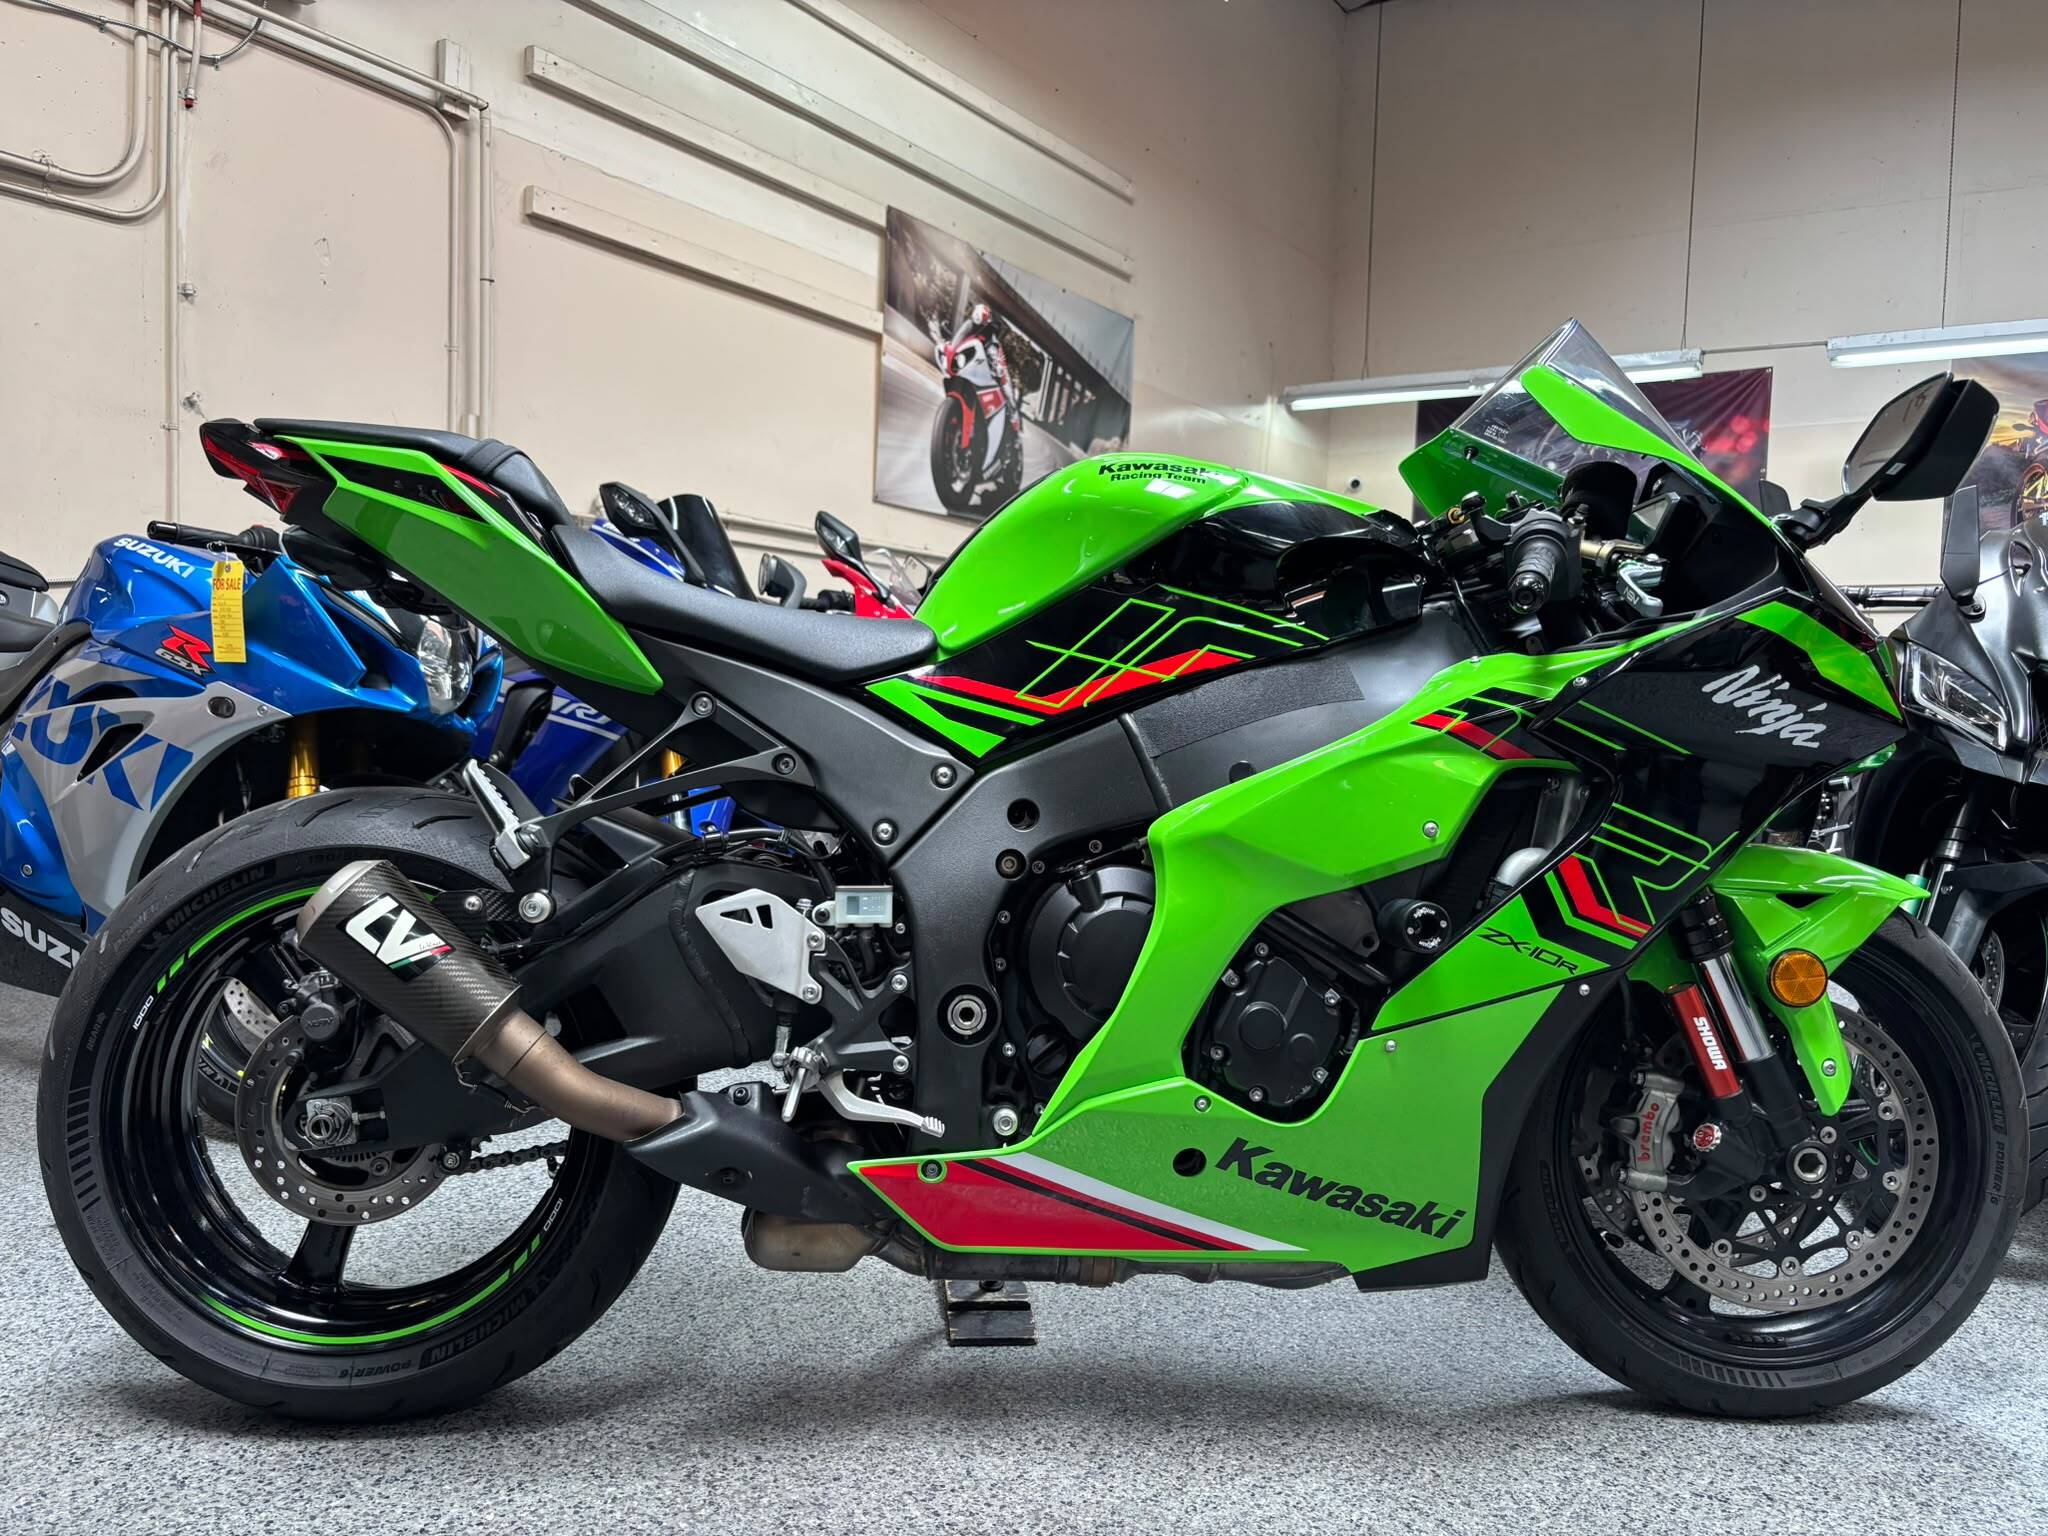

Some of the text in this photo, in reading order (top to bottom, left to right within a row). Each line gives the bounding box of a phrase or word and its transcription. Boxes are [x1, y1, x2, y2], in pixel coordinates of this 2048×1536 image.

[1110, 471, 1206, 484] Racing Team
[114, 538, 195, 578] SUZUKI
[213, 578, 241, 591] FOR SALE
[1702, 664, 1827, 748] Ninja
[165, 866, 265, 931] MICHELIN
[1476, 926, 1579, 976] ZX-10R
[133, 995, 155, 1031] 1000
[1693, 1016, 1728, 1071] SHOWA
[1976, 1050, 2006, 1125] MICHELIN
[1637, 1102, 1660, 1162] brembo
[1215, 1136, 1467, 1240] Kawasaki
[543, 1197, 563, 1232] 1000
[353, 1359, 413, 1378] POWER
